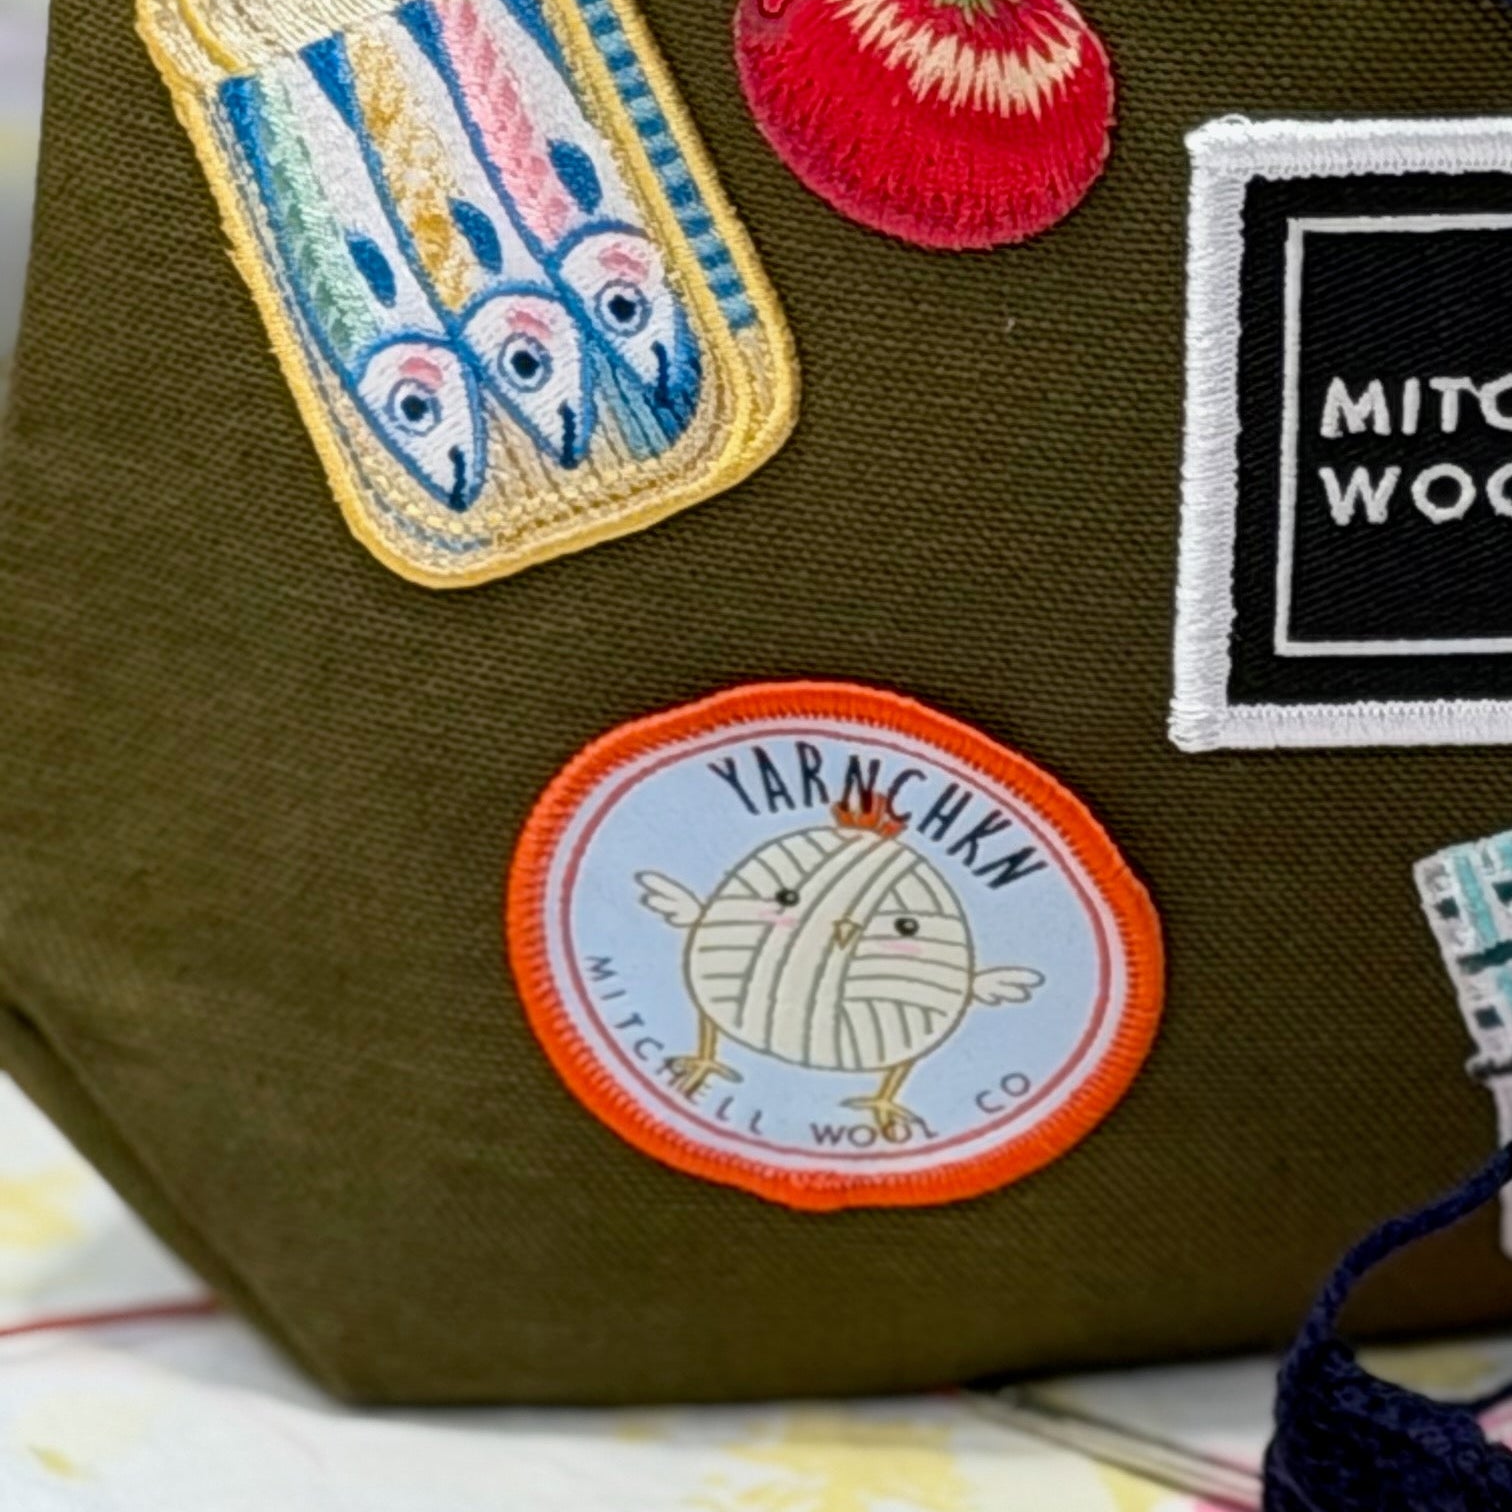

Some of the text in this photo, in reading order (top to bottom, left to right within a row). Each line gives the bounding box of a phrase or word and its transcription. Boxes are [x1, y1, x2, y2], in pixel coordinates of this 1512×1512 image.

[708, 742, 1047, 889] YARNCHKN
[585, 955, 1033, 1150] MITCHELL WOOL CO
